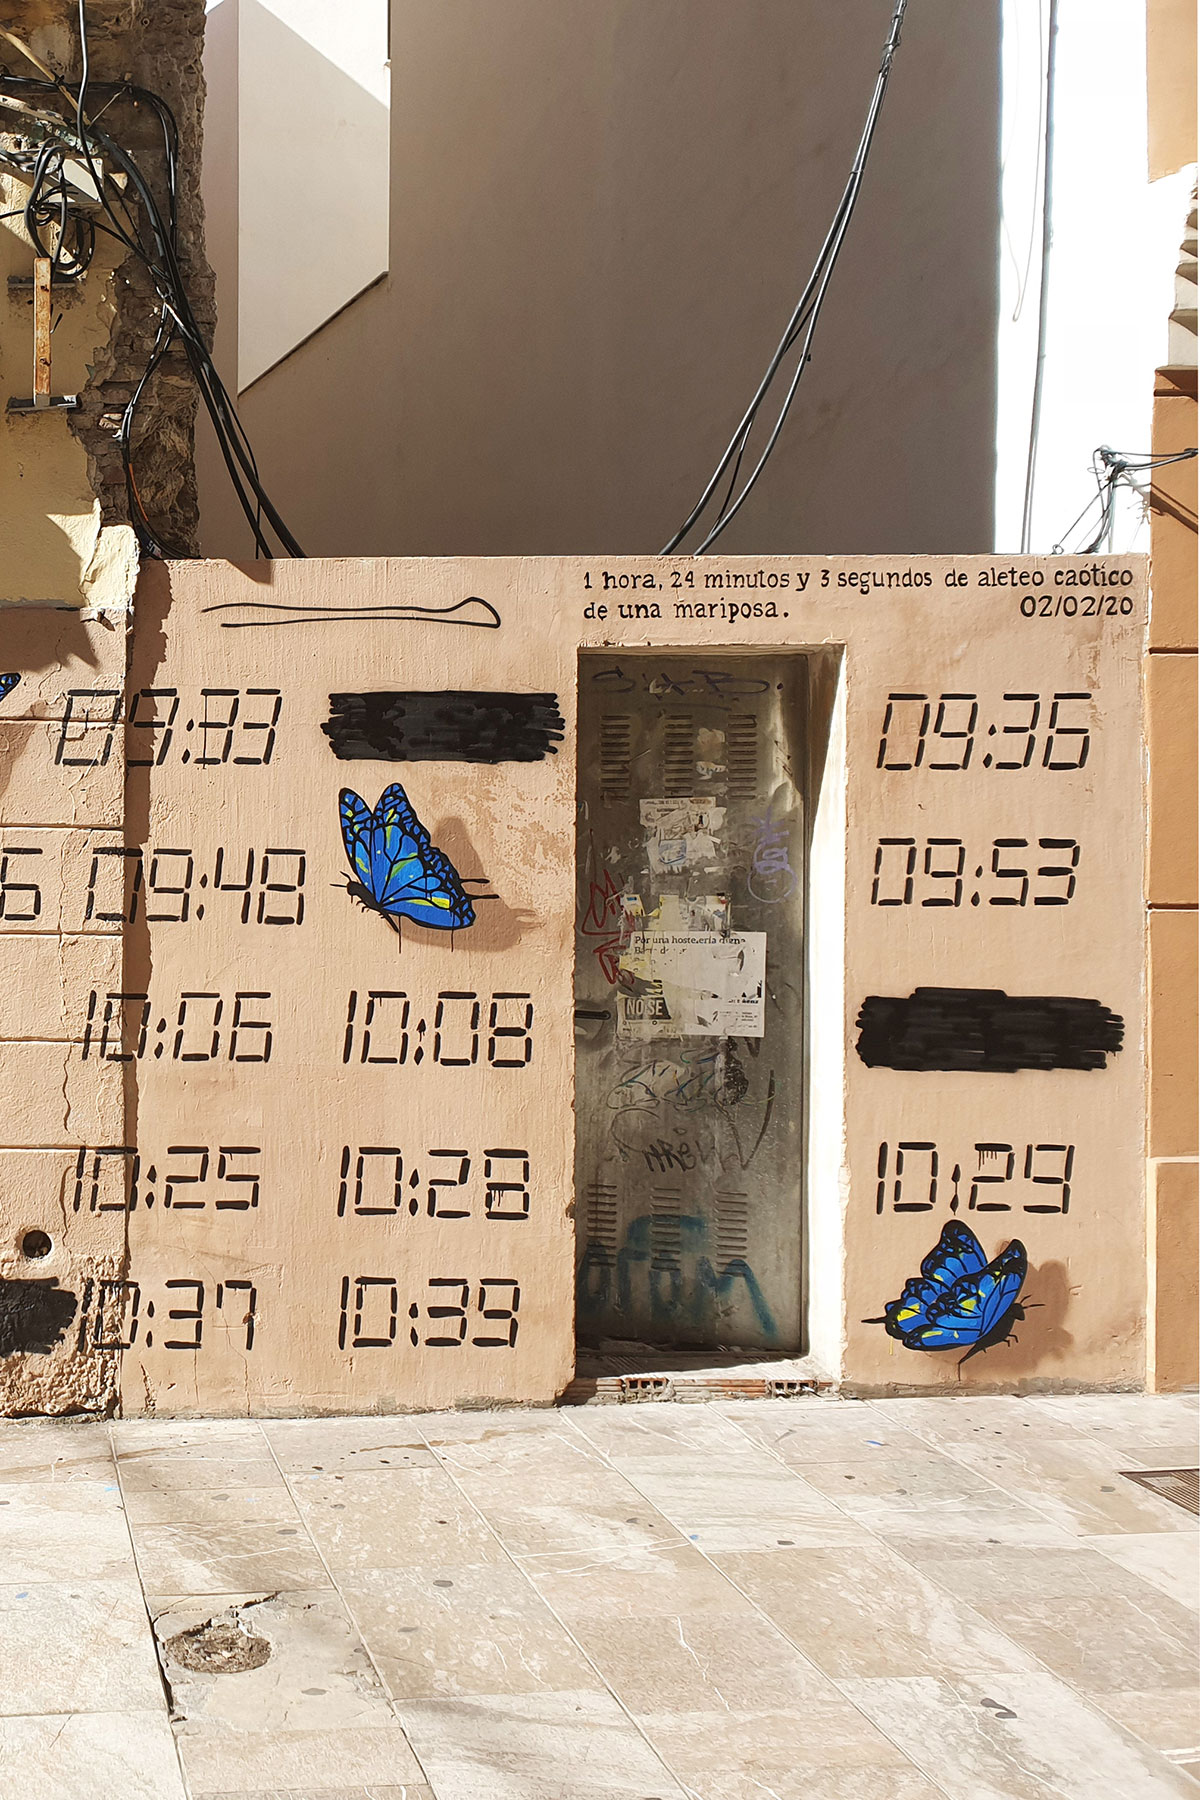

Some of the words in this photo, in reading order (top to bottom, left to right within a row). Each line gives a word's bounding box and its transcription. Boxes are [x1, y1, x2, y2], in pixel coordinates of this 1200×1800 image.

[583, 571, 593, 589] 1
[601, 570, 663, 591] hora,
[670, 570, 696, 589] 24
[704, 569, 790, 589] minutos
[795, 571, 811, 592] y
[820, 569, 830, 588] 3
[837, 567, 933, 595] segundos
[944, 568, 969, 588] de
[977, 567, 1045, 587] aleteo
[1053, 563, 1134, 587] caótico
[583, 601, 609, 621] de
[618, 602, 663, 619] una
[673, 597, 790, 624] mariposa.
[1019, 594, 1134, 618] 02/02/20
[55, 688, 283, 766] 09:33
[876, 692, 1093, 771] 09:36
[85, 847, 307, 925] 09:48
[870, 837, 1080, 907] 09:53
[81, 989, 273, 1064] 10:06
[342, 989, 535, 1068] 10:08
[626, 998, 644, 1016] NO
[72, 1145, 262, 1213] 10:25
[337, 1144, 531, 1221] 10:28
[875, 1141, 1076, 1215] 10:29
[75, 1277, 258, 1352] 10:37
[338, 1275, 522, 1351] 10:39
